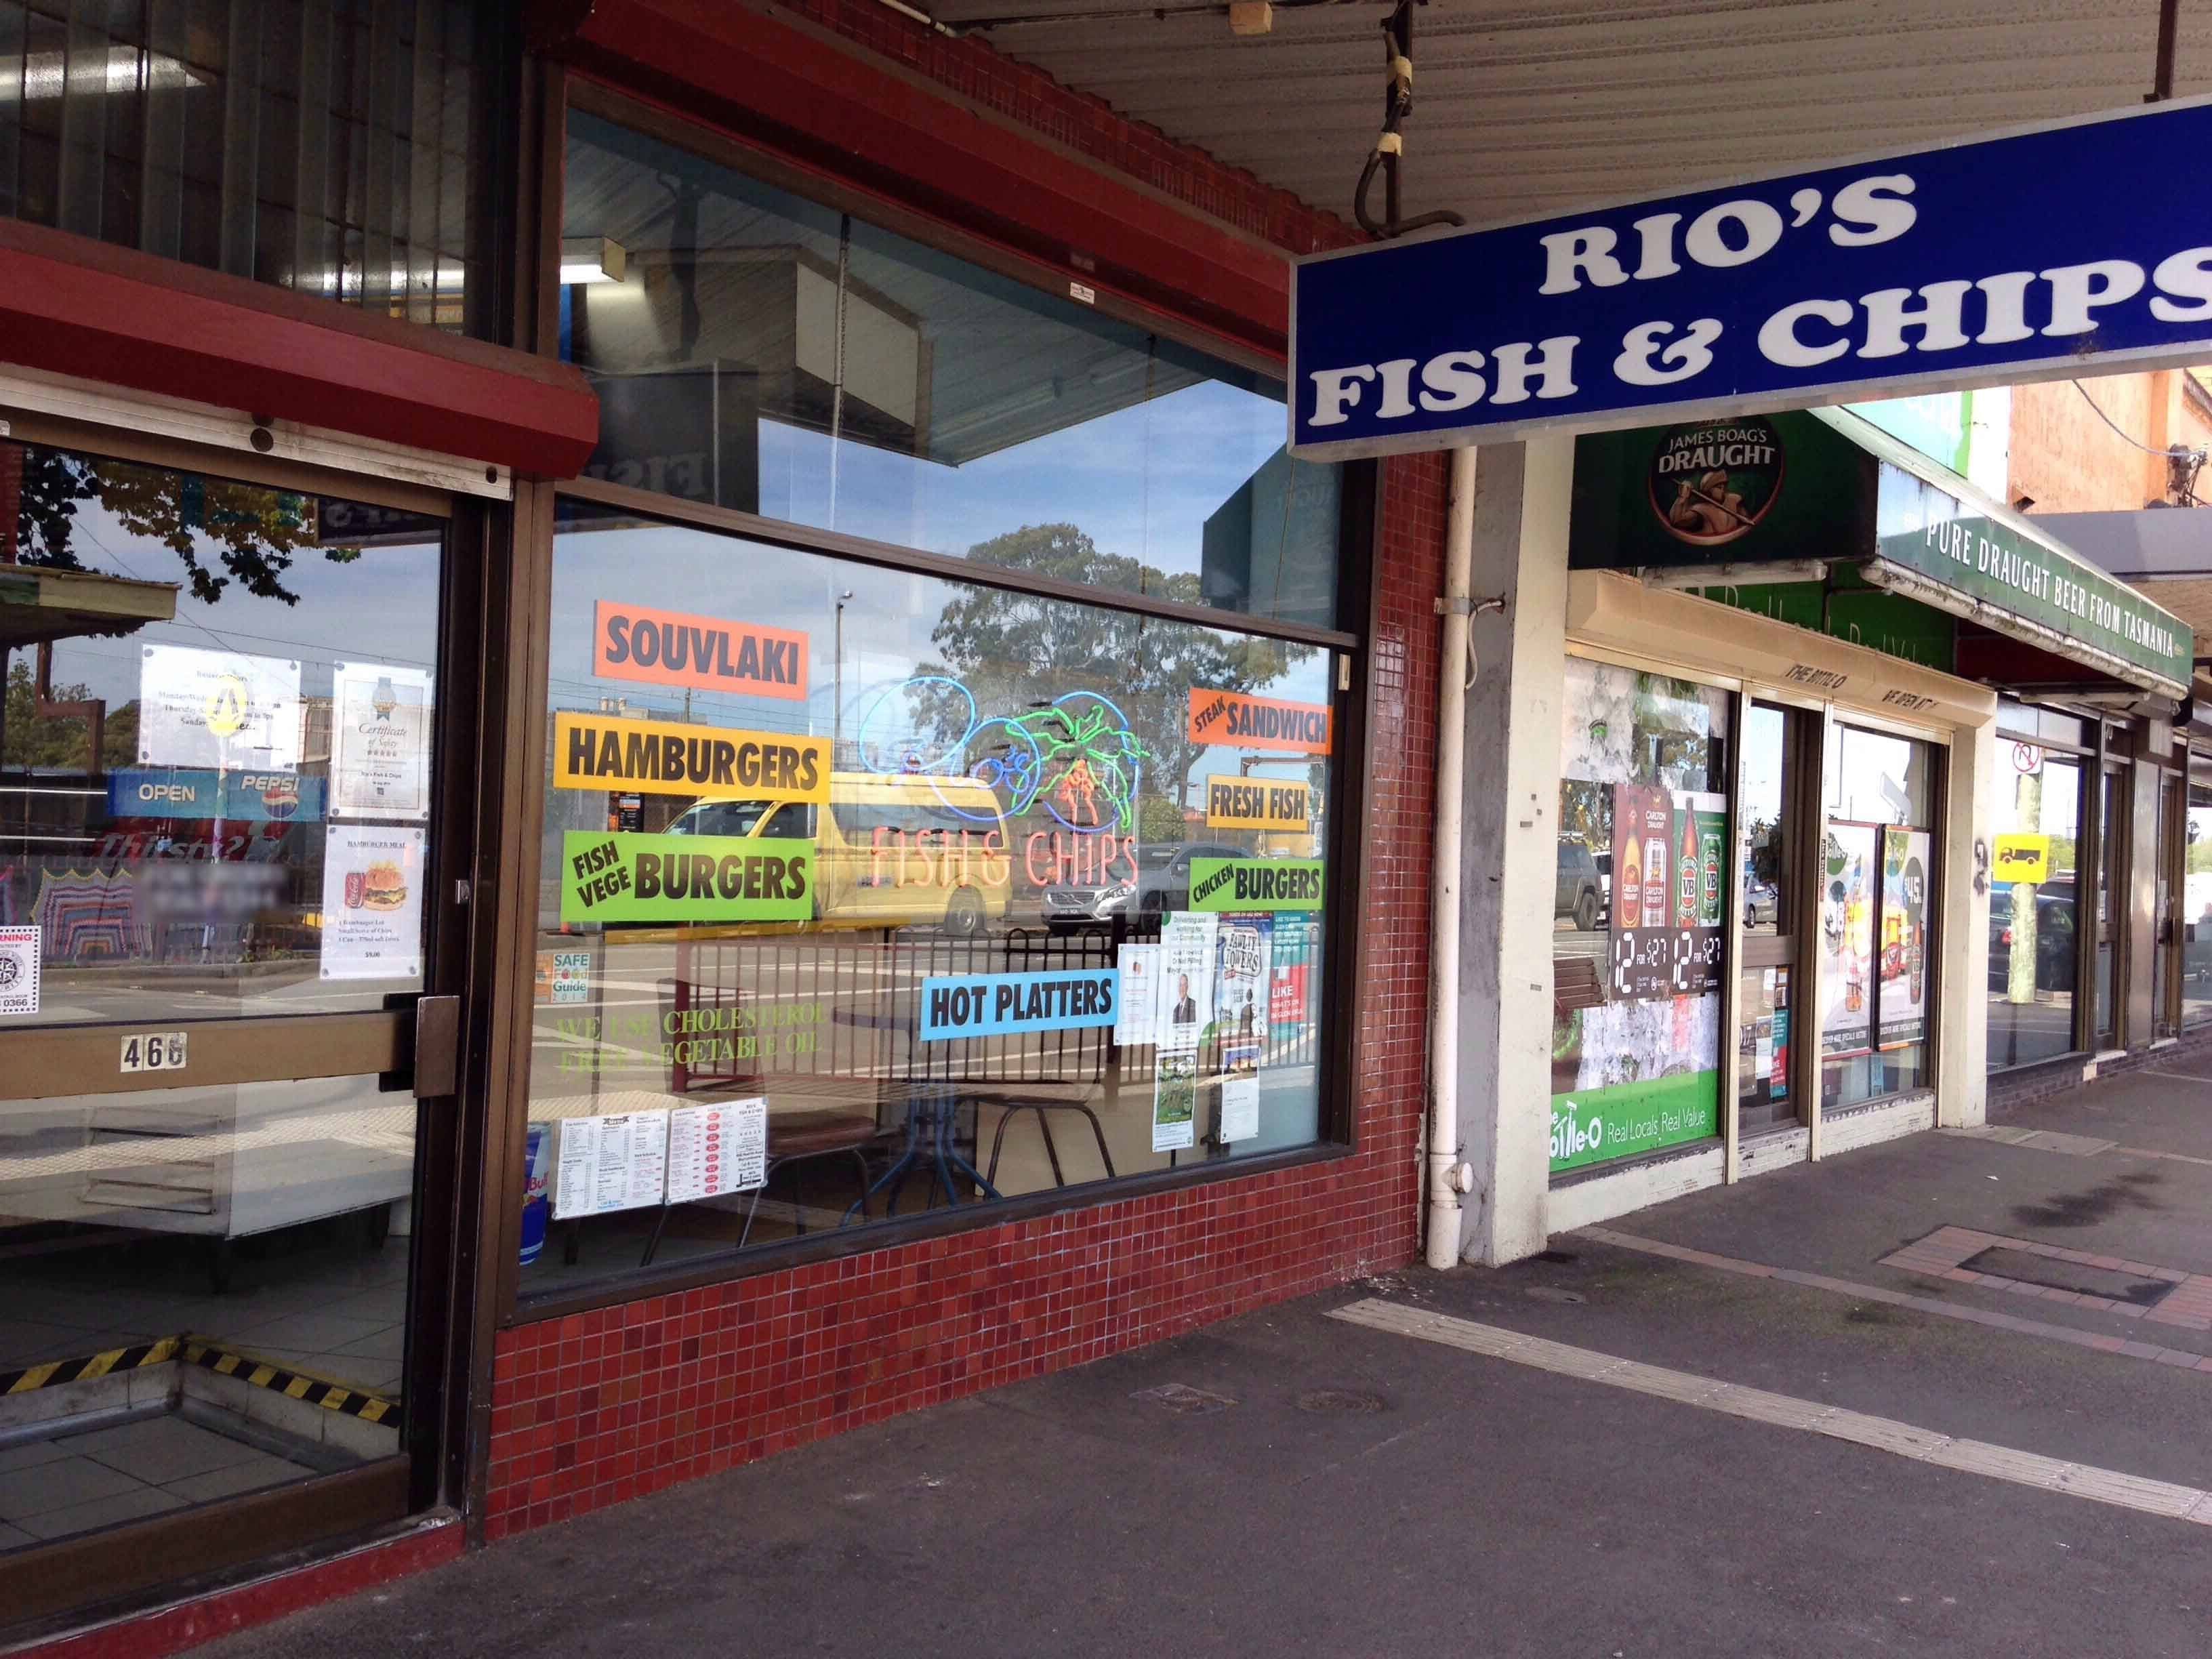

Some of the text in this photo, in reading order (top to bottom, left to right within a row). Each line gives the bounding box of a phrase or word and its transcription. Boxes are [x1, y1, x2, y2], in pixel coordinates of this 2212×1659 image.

[1539, 173, 1917, 295] RIO'S
[1308, 245, 2212, 427] FISH & CHIPS
[1659, 445, 1776, 473] DRAUGHT
[1668, 428, 1767, 453] JAMES BOAG'S
[1926, 516, 2174, 658] PURE DRAUGHT BEER FROM TASMANIA
[605, 615, 799, 685] SOUVLAKI
[359, 722, 407, 737] Certificate
[1195, 695, 1328, 744] STEAK SANDWICH
[567, 726, 819, 792] HAMBURGERS
[138, 783, 195, 802] OPEN
[241, 775, 300, 791] PEPSI
[1210, 783, 1305, 820] FRESH FISH
[1645, 811, 1666, 821] CARLTON
[572, 840, 620, 880] FISH
[871, 826, 1139, 888] FISH & CHIPS
[576, 853, 806, 908] VEGE BURGERS
[1193, 863, 1320, 903] CHICKEN BURGERS
[1683, 879, 1694, 895] VB
[1706, 872, 1717, 888] VB
[554, 954, 588, 966] SAFE
[1229, 933, 1257, 950] FAWLTY
[1673, 931, 1693, 989] 12
[1694, 952, 1702, 962] FOR
[1703, 937, 1721, 964] $27
[1225, 948, 1258, 975] TOWERS
[1615, 933, 1635, 994] 12
[1637, 954, 1645, 964] FOR
[1647, 939, 1666, 966] $27
[553, 981, 586, 991] Guide
[930, 985, 987, 1027] HOT
[996, 978, 1112, 1022] PLATTERS
[1272, 985, 1293, 998] LIKE
[663, 1002, 826, 1036] CHOLESTEROL
[641, 1034, 777, 1069] VEGETABLE
[785, 1031, 823, 1054] OIL
[1551, 1101, 1602, 1158] ottle-O
[1608, 1120, 1626, 1144] Real
[1662, 1111, 1680, 1132] Real
[1682, 1107, 1706, 1127] Value
[529, 1172, 548, 1191] Bull
